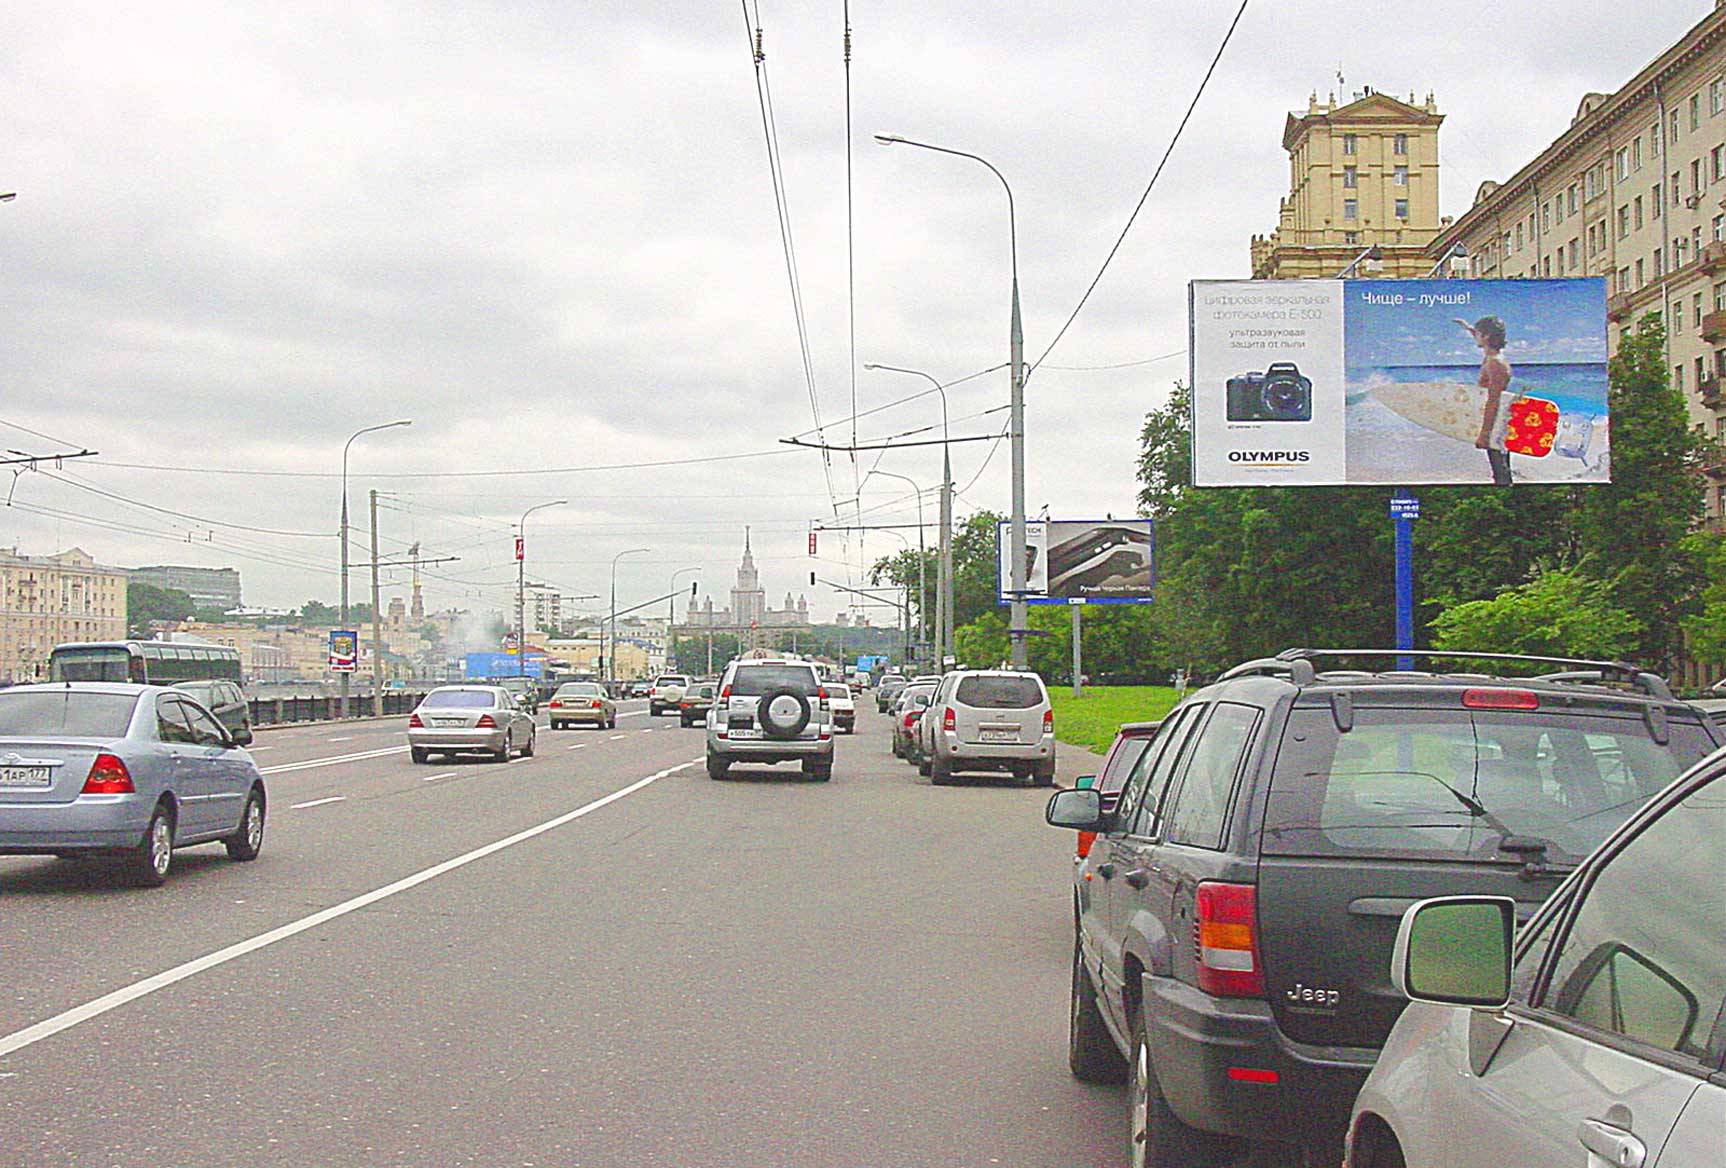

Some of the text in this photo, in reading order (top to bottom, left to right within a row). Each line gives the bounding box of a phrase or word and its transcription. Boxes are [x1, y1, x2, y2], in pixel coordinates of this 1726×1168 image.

[1265, 295, 1330, 306] зеркальная
[1361, 291, 1403, 306] Чище
[1419, 291, 1471, 307] лучше!
[1228, 329, 1306, 338] ультразвуковая
[1230, 340, 1266, 349] защита
[1228, 451, 1311, 462] OLYMPUS
[1287, 983, 1340, 1006] Jeep
